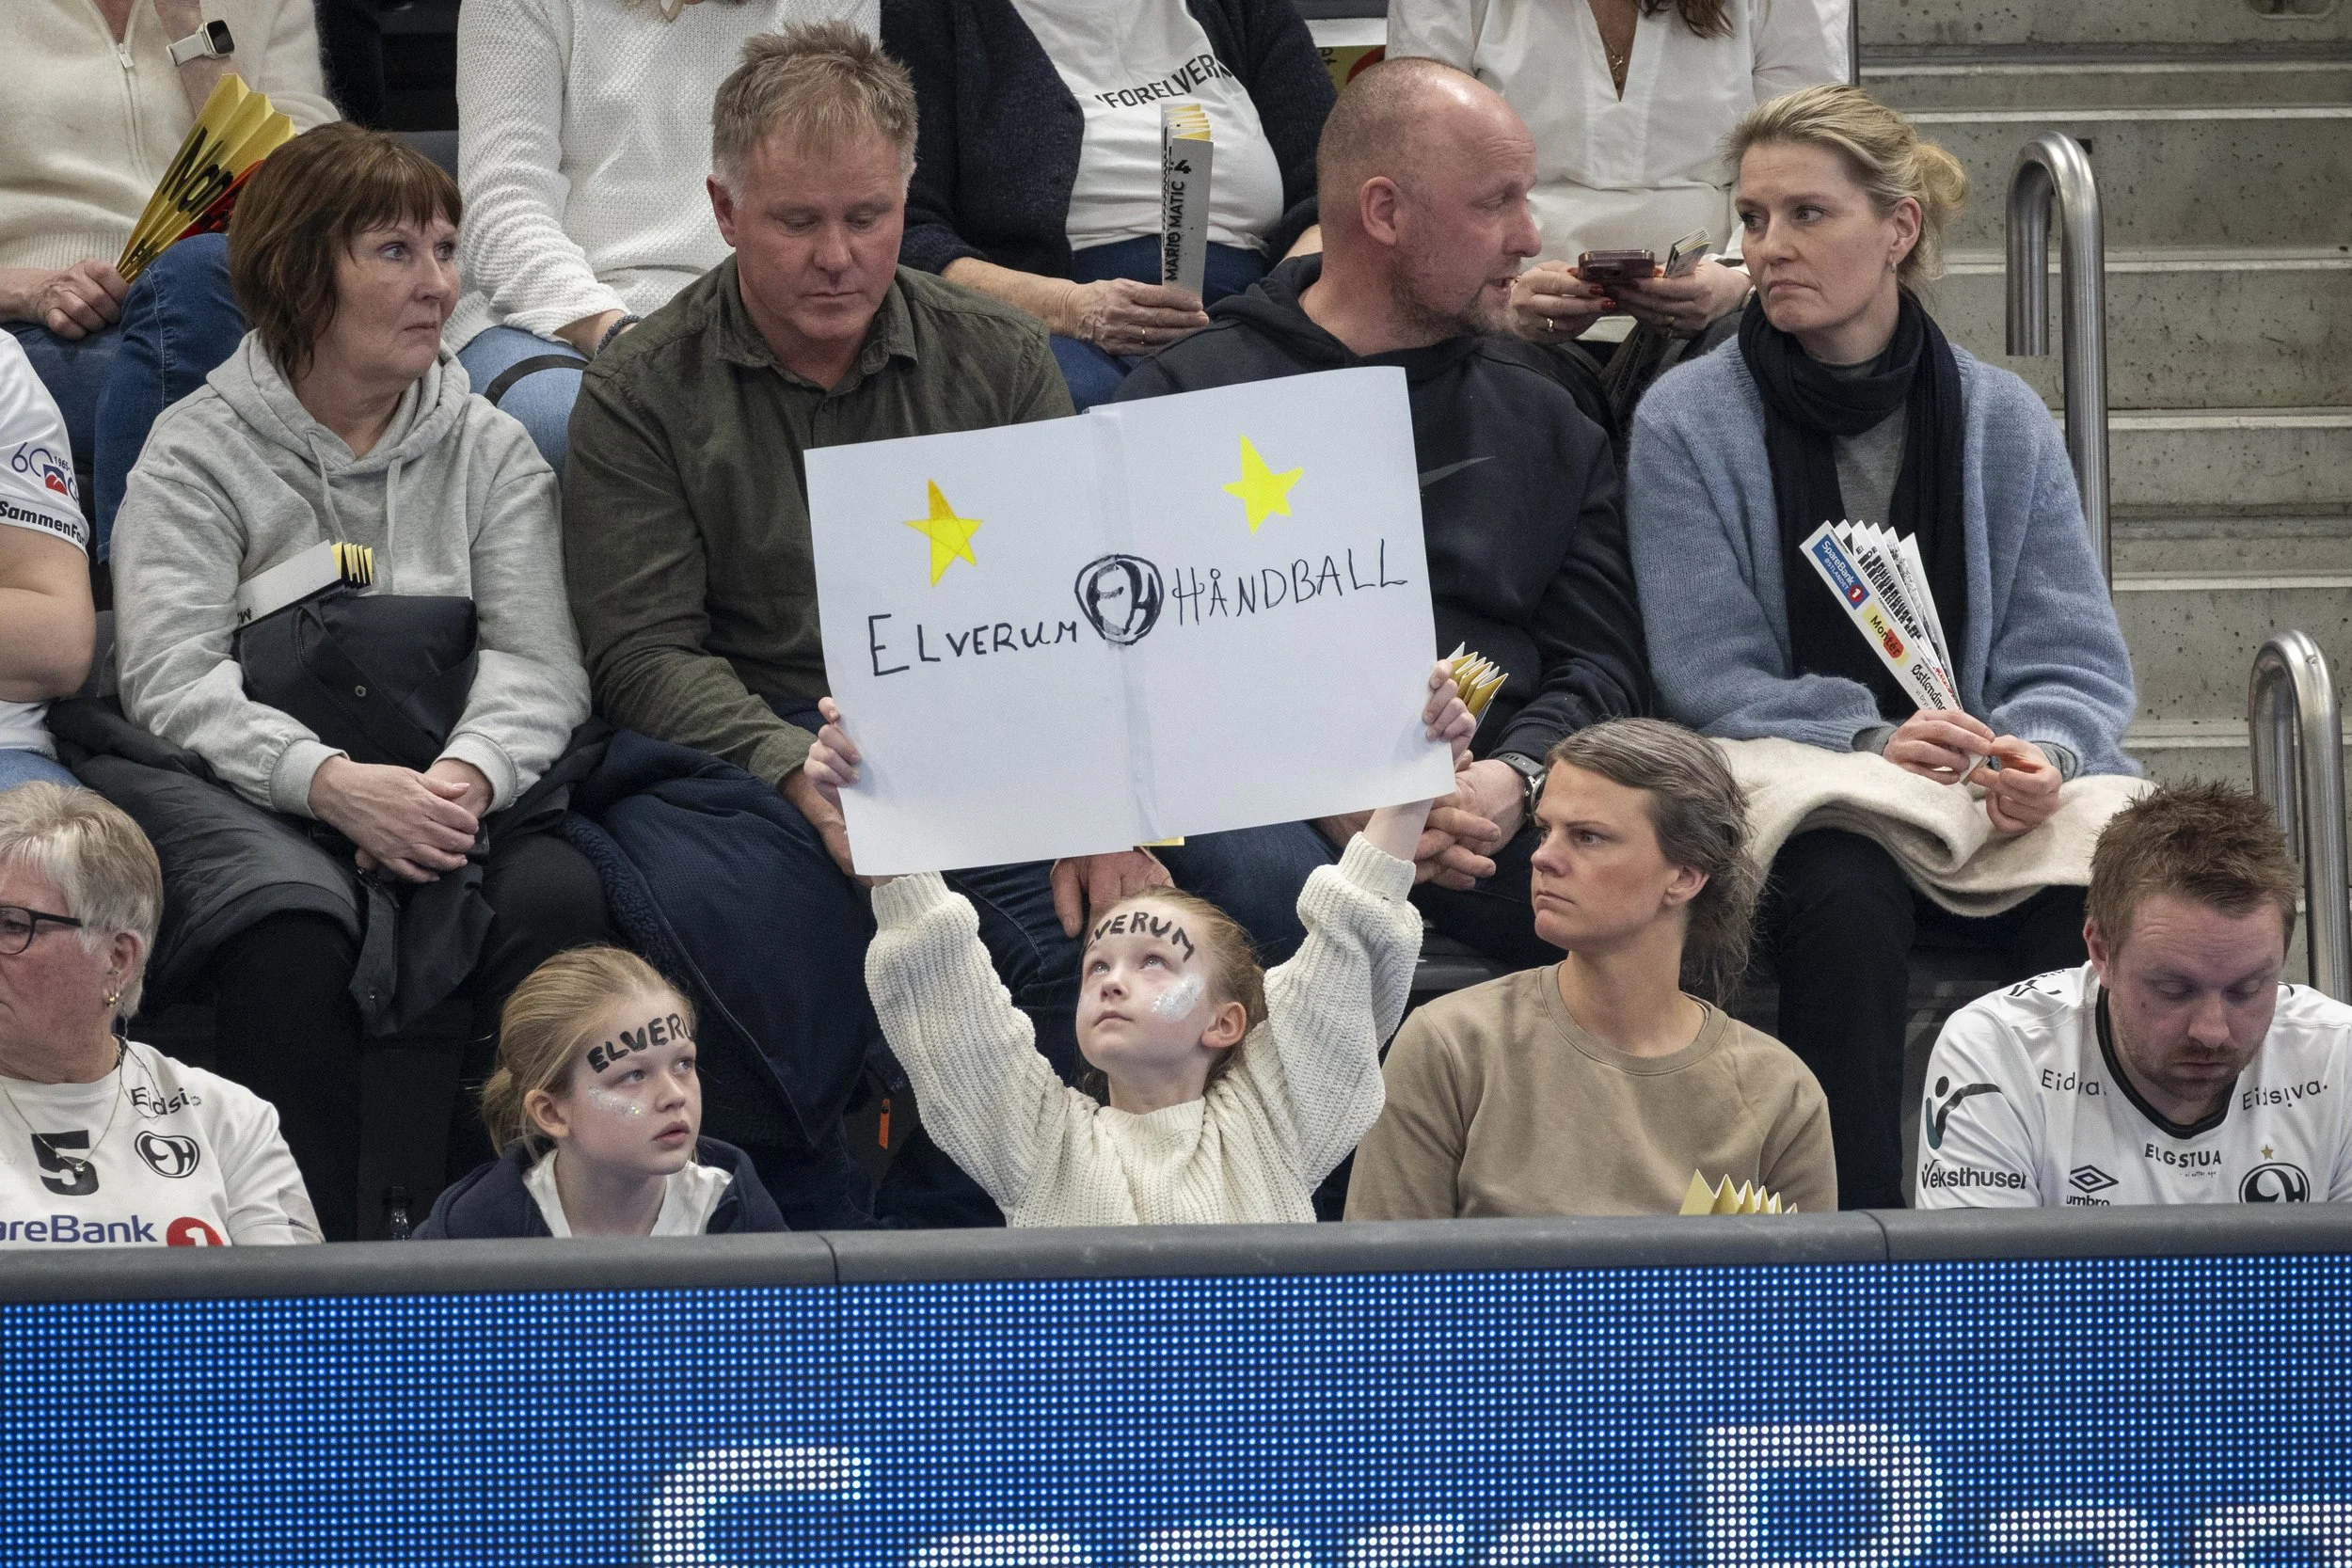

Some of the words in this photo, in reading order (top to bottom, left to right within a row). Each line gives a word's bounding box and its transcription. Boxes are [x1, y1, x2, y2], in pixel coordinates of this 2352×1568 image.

[1095, 54, 1232, 108] FORELVER
[1168, 182, 1184, 228] MATIC
[1821, 541, 1854, 586] SpareBank
[868, 612, 1077, 676] ELVERUM
[1172, 539, 1408, 626] HÅNDBALL
[1870, 615, 1900, 655] Montér
[1086, 911, 1195, 963] VERUM
[30, 1130, 100, 1196] 5
[2145, 1143, 2222, 1168] ELGSTUA
